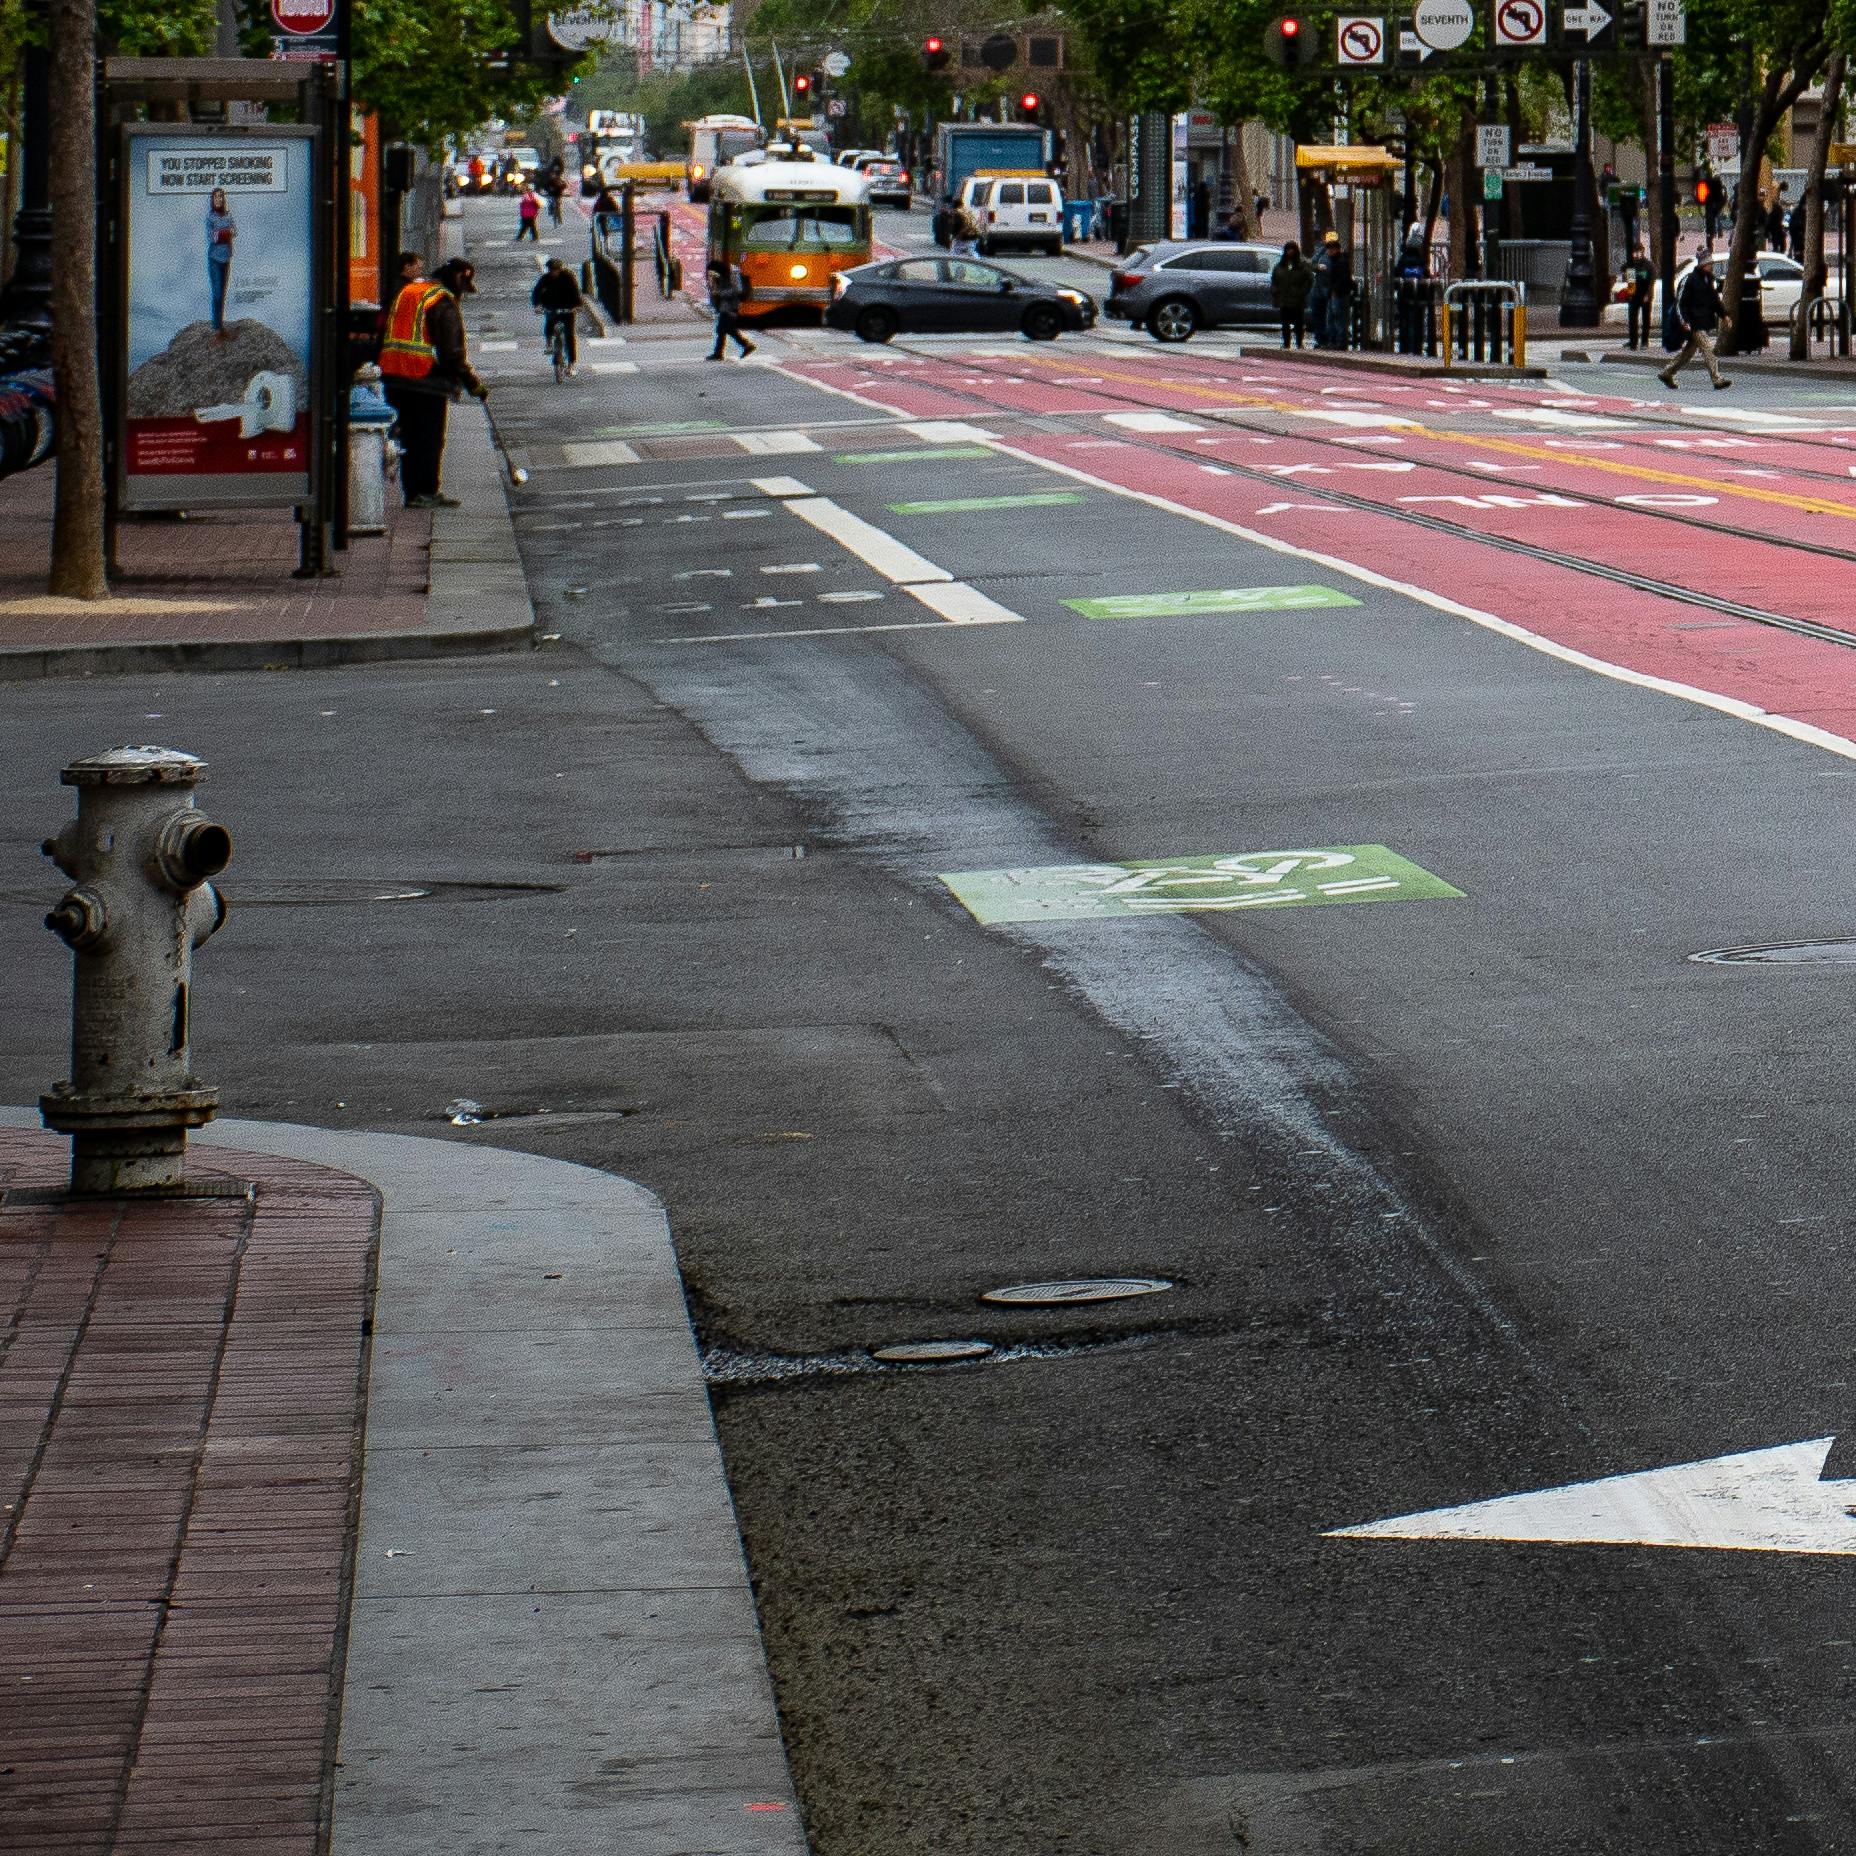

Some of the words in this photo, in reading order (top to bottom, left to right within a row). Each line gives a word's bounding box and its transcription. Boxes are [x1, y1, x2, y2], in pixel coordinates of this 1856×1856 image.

[1657, 1, 1676, 12] NO
[1421, 14, 1469, 26] SEVENTH
[1656, 13, 1679, 23] TURN
[1659, 24, 1675, 33] ON
[1658, 33, 1676, 42] RED
[161, 158, 182, 170] YOU
[184, 157, 227, 170] STOPPED
[228, 156, 273, 169] SMOKING
[161, 173, 184, 186] NOW
[186, 173, 217, 186] START
[219, 172, 273, 186] SCREENING
